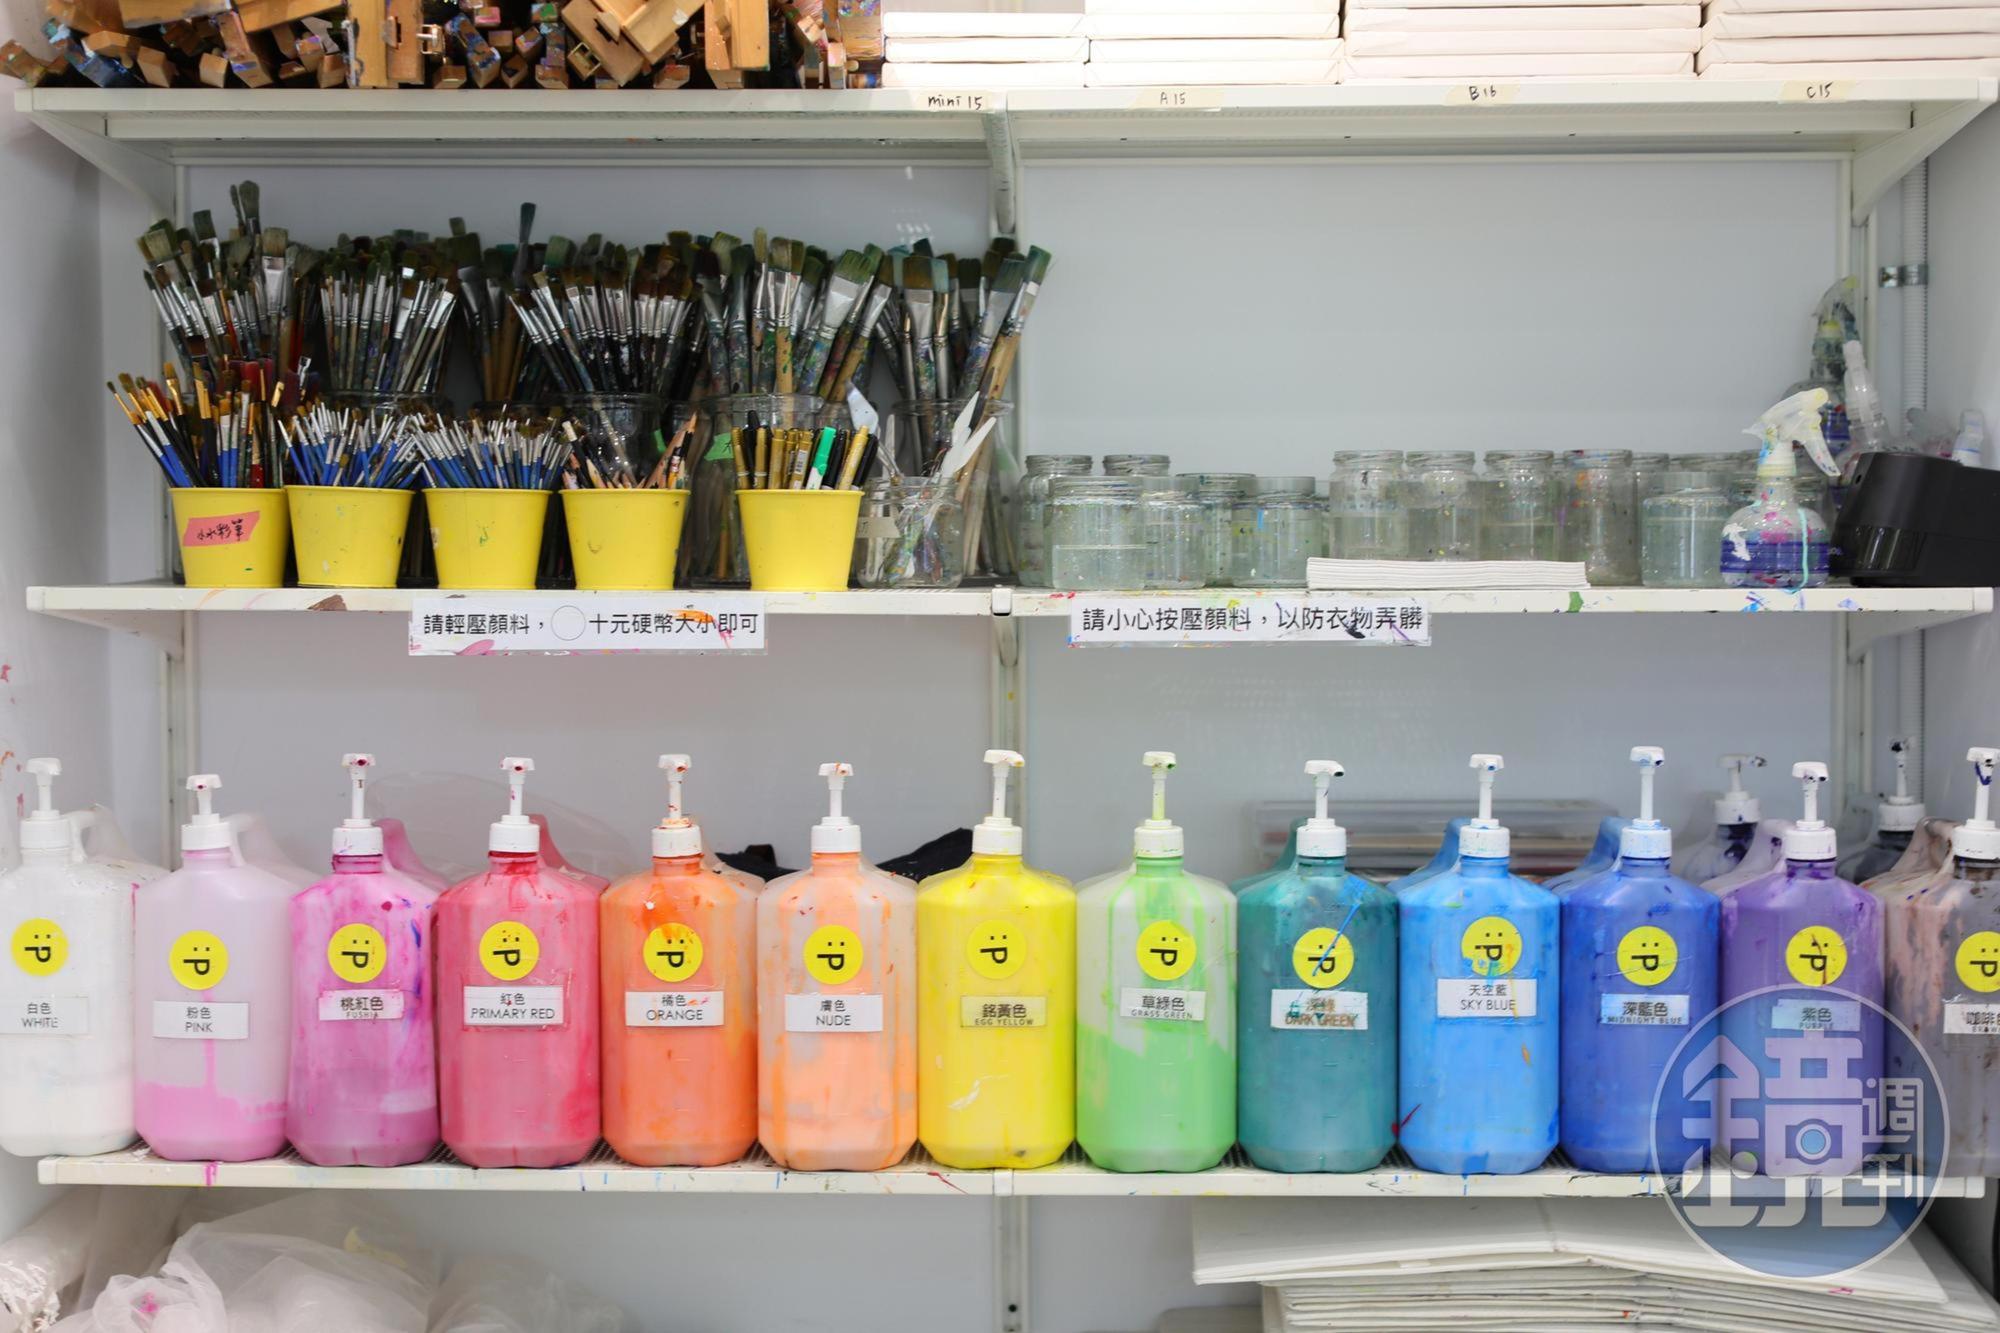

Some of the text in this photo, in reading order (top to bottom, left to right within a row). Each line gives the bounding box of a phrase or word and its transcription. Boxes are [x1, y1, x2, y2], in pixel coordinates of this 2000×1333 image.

[928, 94, 983, 111] mini 15
[1469, 984, 1507, 997] 天空藍
[341, 996, 384, 1011] 桃紅色
[500, 992, 526, 1006] 紅色
[1142, 995, 1185, 1011] 草綠色
[1461, 999, 1516, 1011] SKY BLUE
[27, 1002, 52, 1015] 白色
[187, 1006, 212, 1019] 粉色
[471, 1007, 555, 1019] PRIMARY RED
[646, 1009, 703, 1021] ORANGE
[1131, 1009, 1193, 1019] GRASS GREEN
[1801, 1007, 1832, 1023] 紫色
[21, 1017, 59, 1029] WHITE
[816, 1014, 851, 1026] NUDE
[975, 1018, 1034, 1026] EGG YELLOW
[1966, 1011, 2000, 1026] 咖啡
[185, 1022, 213, 1033] PINK
